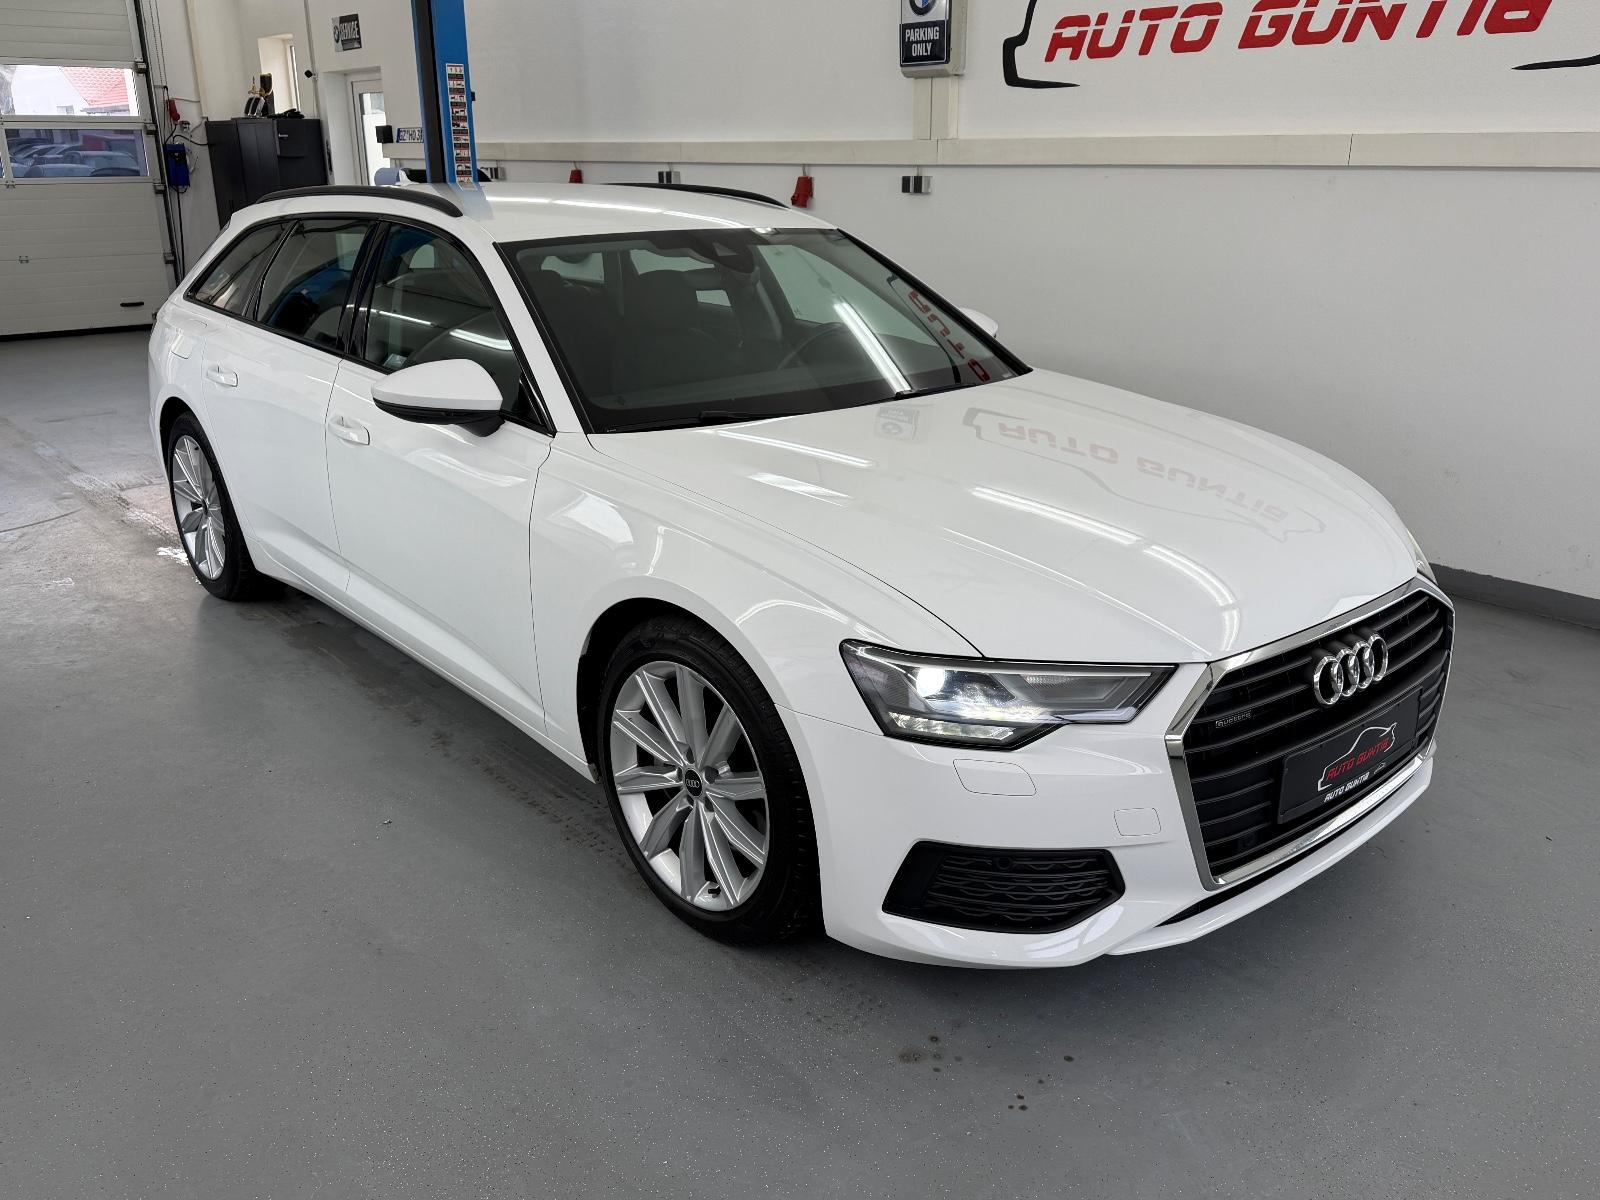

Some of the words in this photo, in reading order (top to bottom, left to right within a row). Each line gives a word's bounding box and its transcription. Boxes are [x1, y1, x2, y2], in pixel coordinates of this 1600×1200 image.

[905, 26, 940, 42] PARKING
[1044, 1, 1223, 62] AUTO
[911, 42, 932, 57] ONLY
[1326, 758, 1356, 781] AUTO
